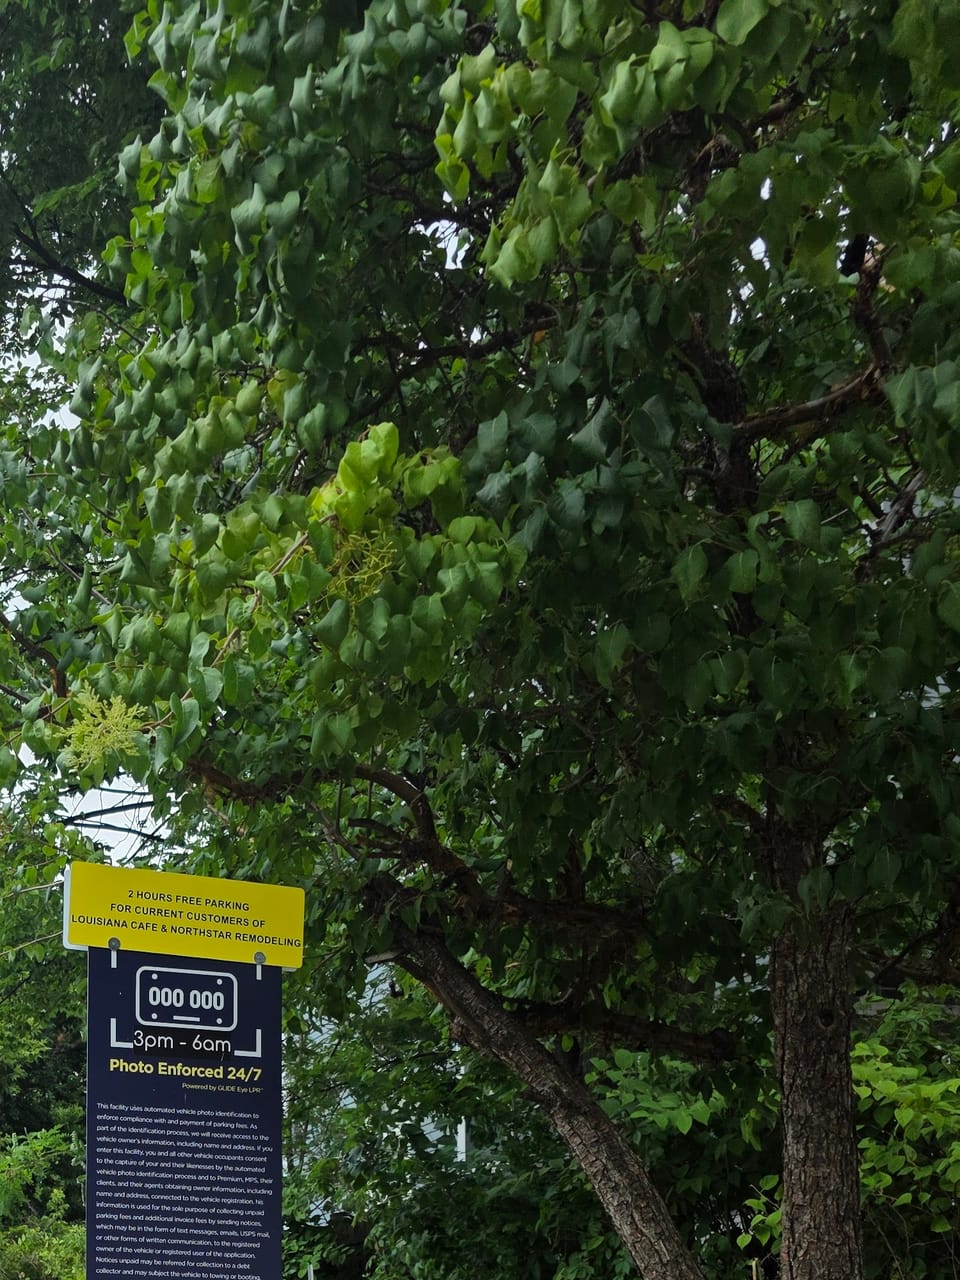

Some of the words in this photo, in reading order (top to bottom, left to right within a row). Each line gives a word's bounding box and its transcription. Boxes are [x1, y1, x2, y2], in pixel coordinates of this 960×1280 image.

[128, 890, 134, 898] 2
[136, 891, 172, 903] HOURS
[176, 894, 202, 906] FREE
[205, 898, 250, 912] PARKING
[110, 903, 132, 914] FOR
[134, 906, 184, 919] CURRENT
[186, 912, 249, 926] CUSTOMERS
[252, 919, 266, 928] OF
[72, 914, 128, 929] LOUISIANA
[130, 920, 158, 932] CAFE
[160, 924, 168, 932] &
[170, 925, 232, 940] NORTHSTAR
[235, 932, 301, 948] REMODELING
[148, 986, 184, 1008] 000
[190, 990, 225, 1010] 000
[133, 1030, 174, 1052] 3pm
[192, 1034, 231, 1052] 6am
[109, 1058, 154, 1075] Photo
[158, 1062, 224, 1079] Enforced
[227, 1066, 262, 1082] 24/7
[110, 1104, 128, 1112] facility
[197, 1109, 214, 1118] photo
[216, 1110, 252, 1118] identification
[120, 1115, 152, 1124] compliance
[180, 1119, 204, 1128] payment
[213, 1121, 234, 1130] parking
[177, 1140, 202, 1149] including
[215, 1154, 243, 1162] occupants
[144, 1182, 163, 1190] agents
[165, 1183, 192, 1192] obtaining
[247, 1188, 272, 1196] including
[96, 1212, 118, 1221] parking
[217, 1218, 239, 1227] sending
[217, 1208, 244, 1216] collecting
[245, 1209, 264, 1217] unpaid
[232, 1241, 260, 1249] registered
[162, 1249, 191, 1257] registered
[119, 1258, 139, 1266] unpaid
[149, 1270, 169, 1278] subject
[210, 1272, 229, 1280] towing
